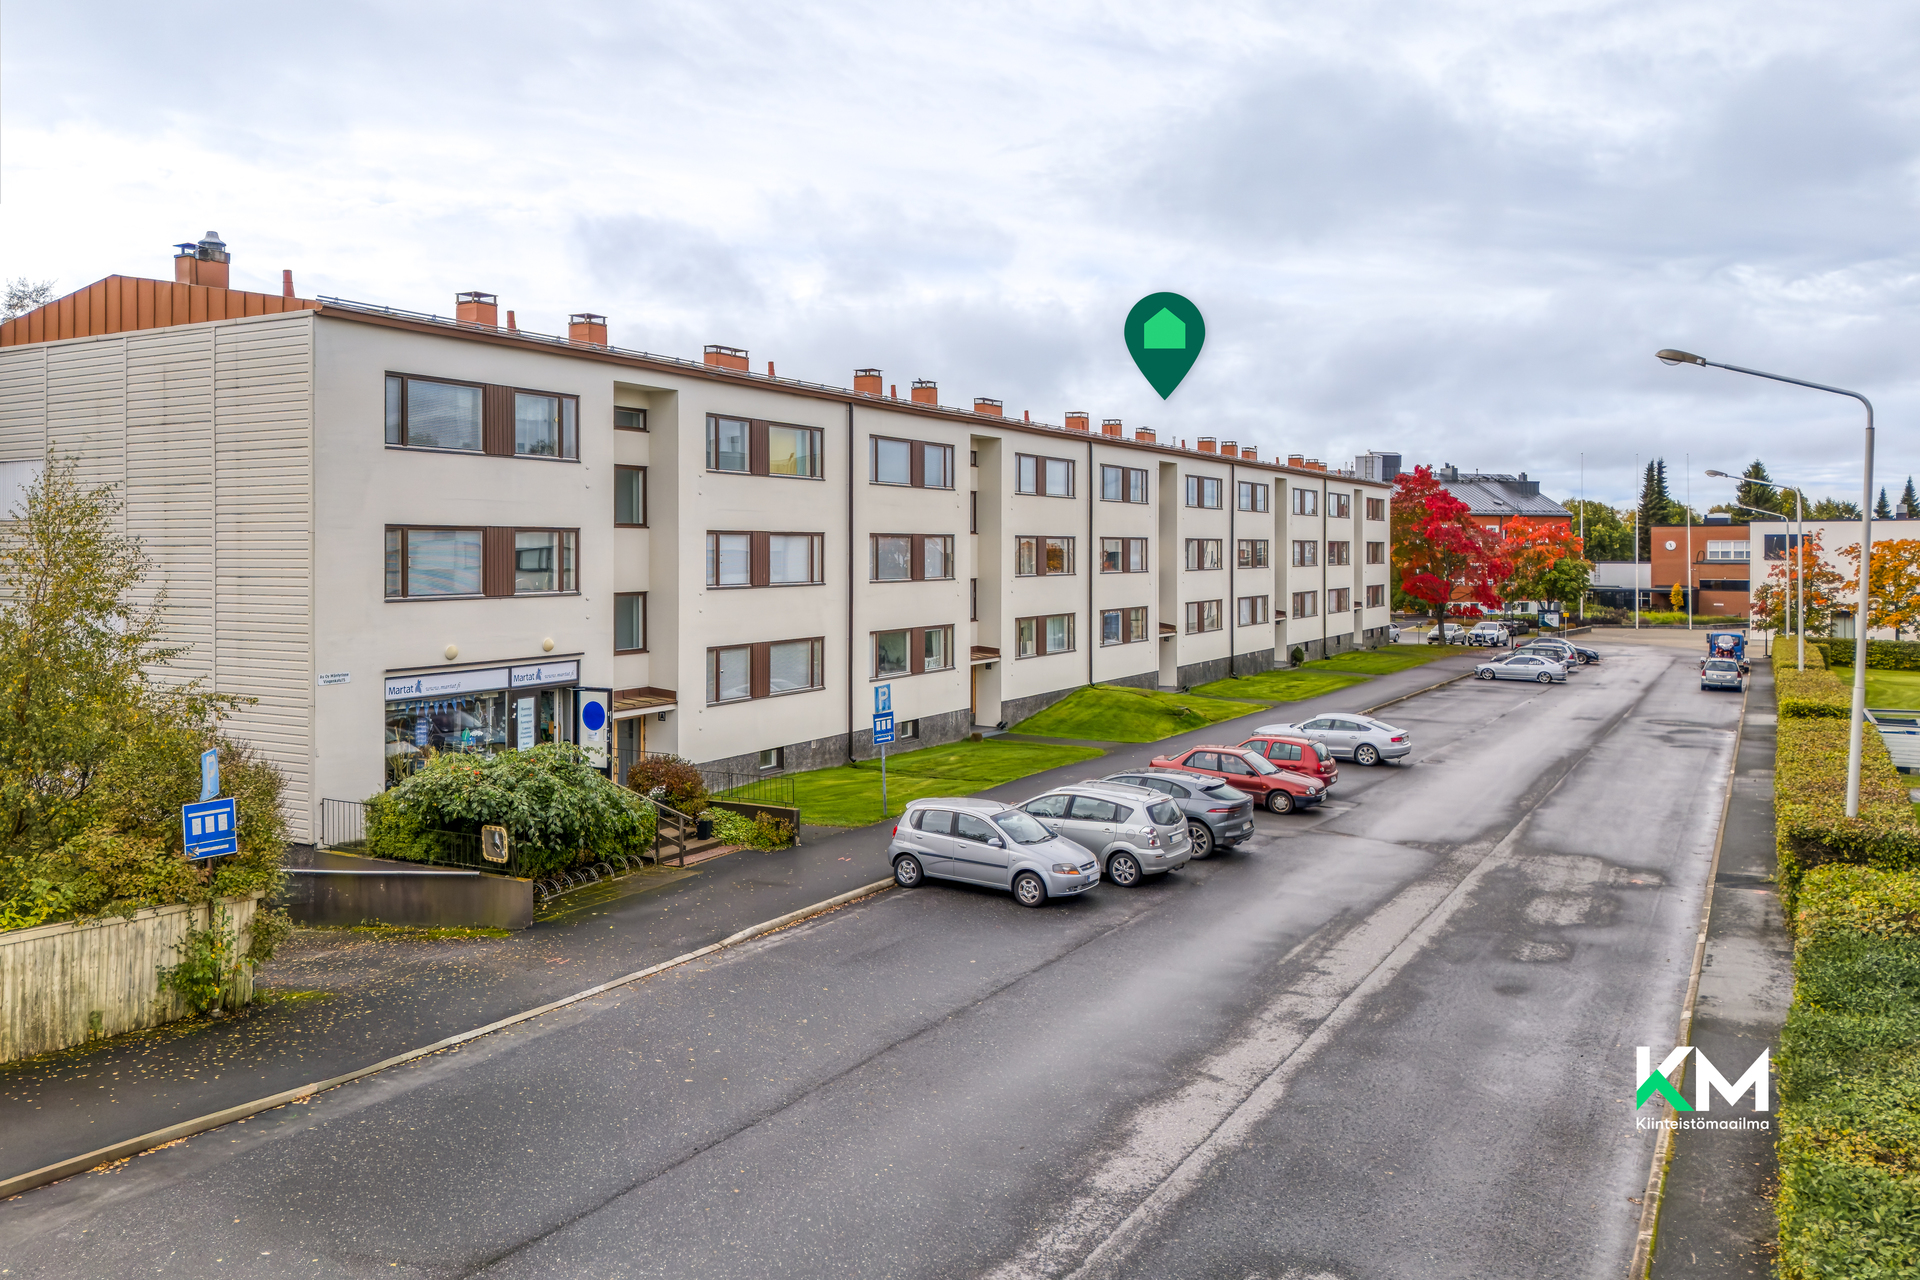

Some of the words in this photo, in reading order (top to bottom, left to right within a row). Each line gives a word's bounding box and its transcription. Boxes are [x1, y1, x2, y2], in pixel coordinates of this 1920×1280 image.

[513, 673, 535, 682] Martat
[544, 670, 575, 678] www.martat.fi
[388, 685, 414, 695] Martat
[425, 681, 461, 691] www.martat.fi
[878, 687, 889, 710] P
[206, 754, 216, 795] P
